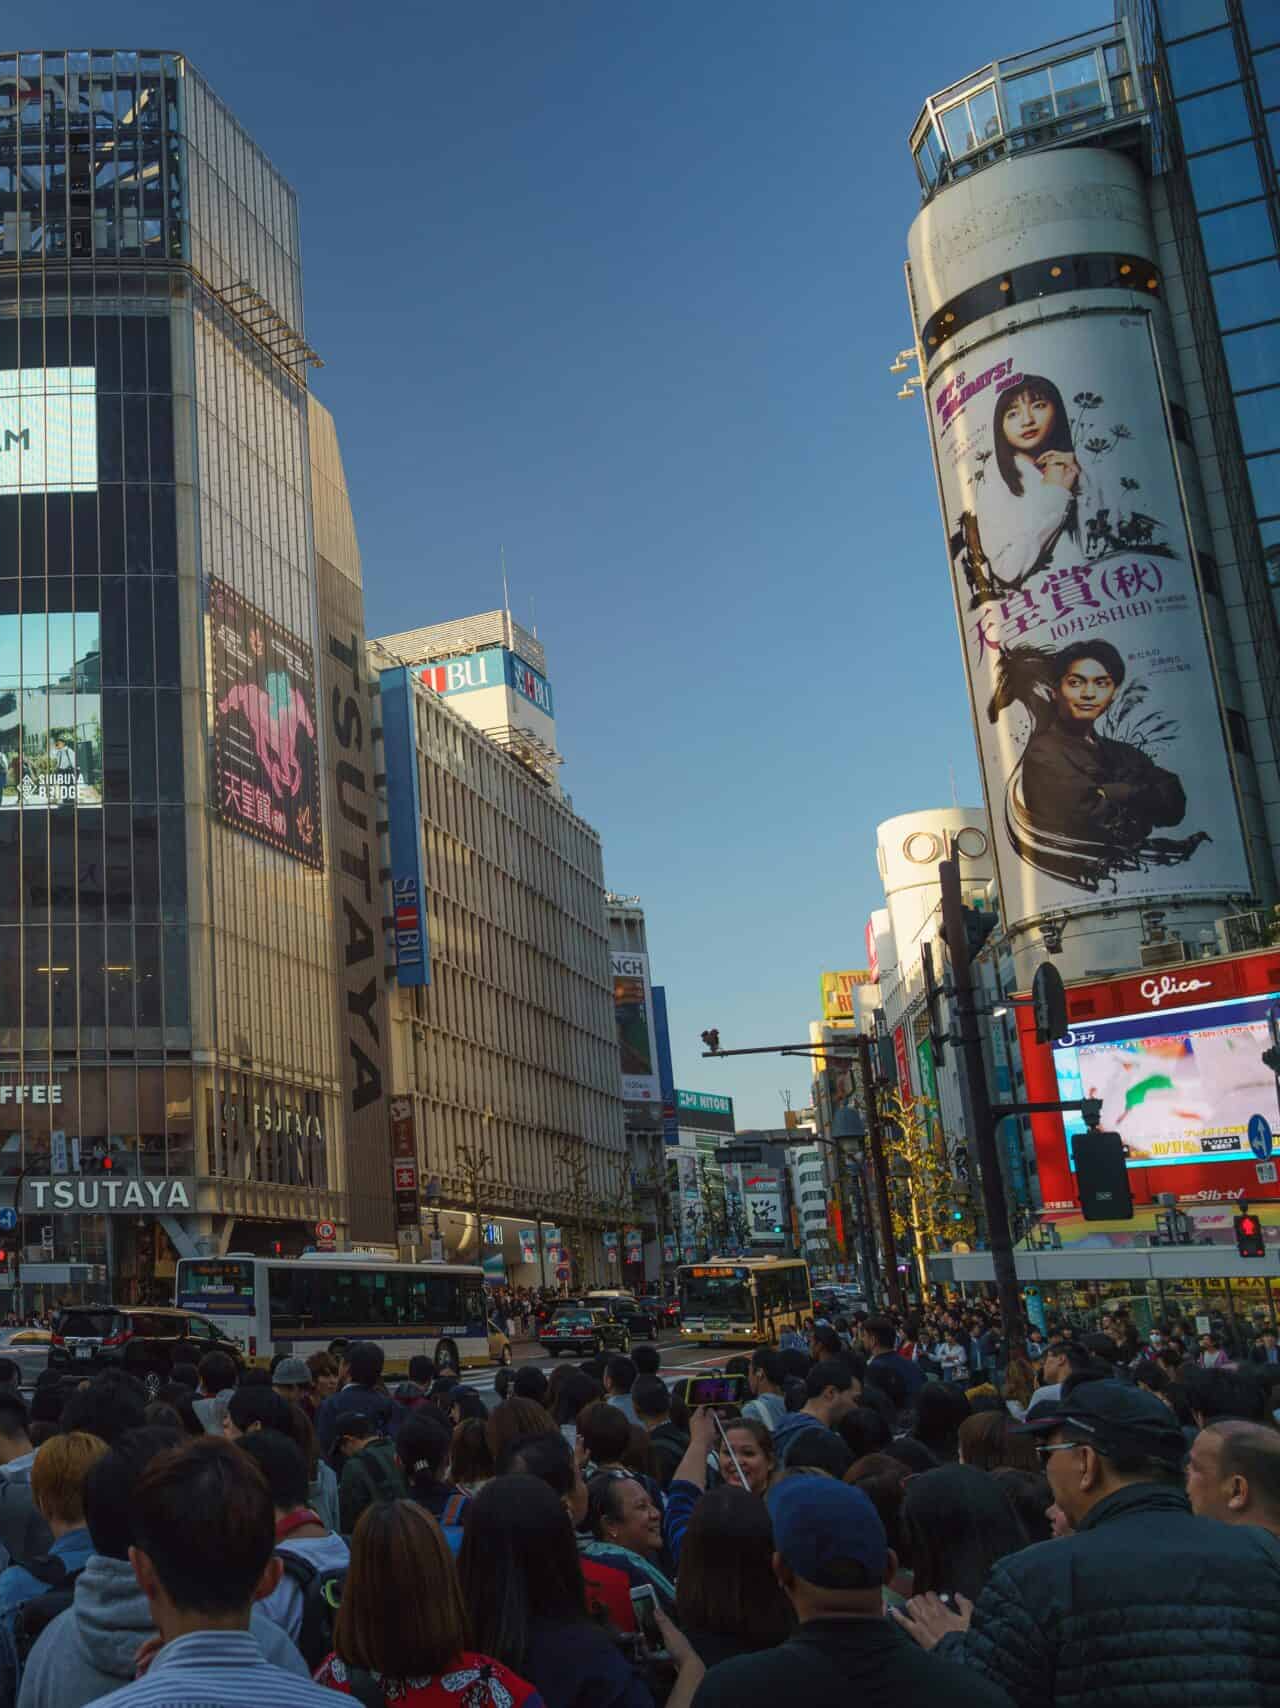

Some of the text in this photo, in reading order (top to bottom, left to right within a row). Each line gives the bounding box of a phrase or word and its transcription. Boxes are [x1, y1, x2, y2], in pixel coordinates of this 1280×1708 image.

[969, 559, 1163, 664] 天皇賞(秋)
[1050, 601, 1152, 640] 10月28日(日)
[329, 631, 383, 1113] TSUTAYA
[393, 879, 420, 966] SEIBU
[1140, 975, 1212, 1006] Glico
[253, 1103, 323, 1141] TSUTAYA
[30, 1181, 190, 1209] TSUTAYA
